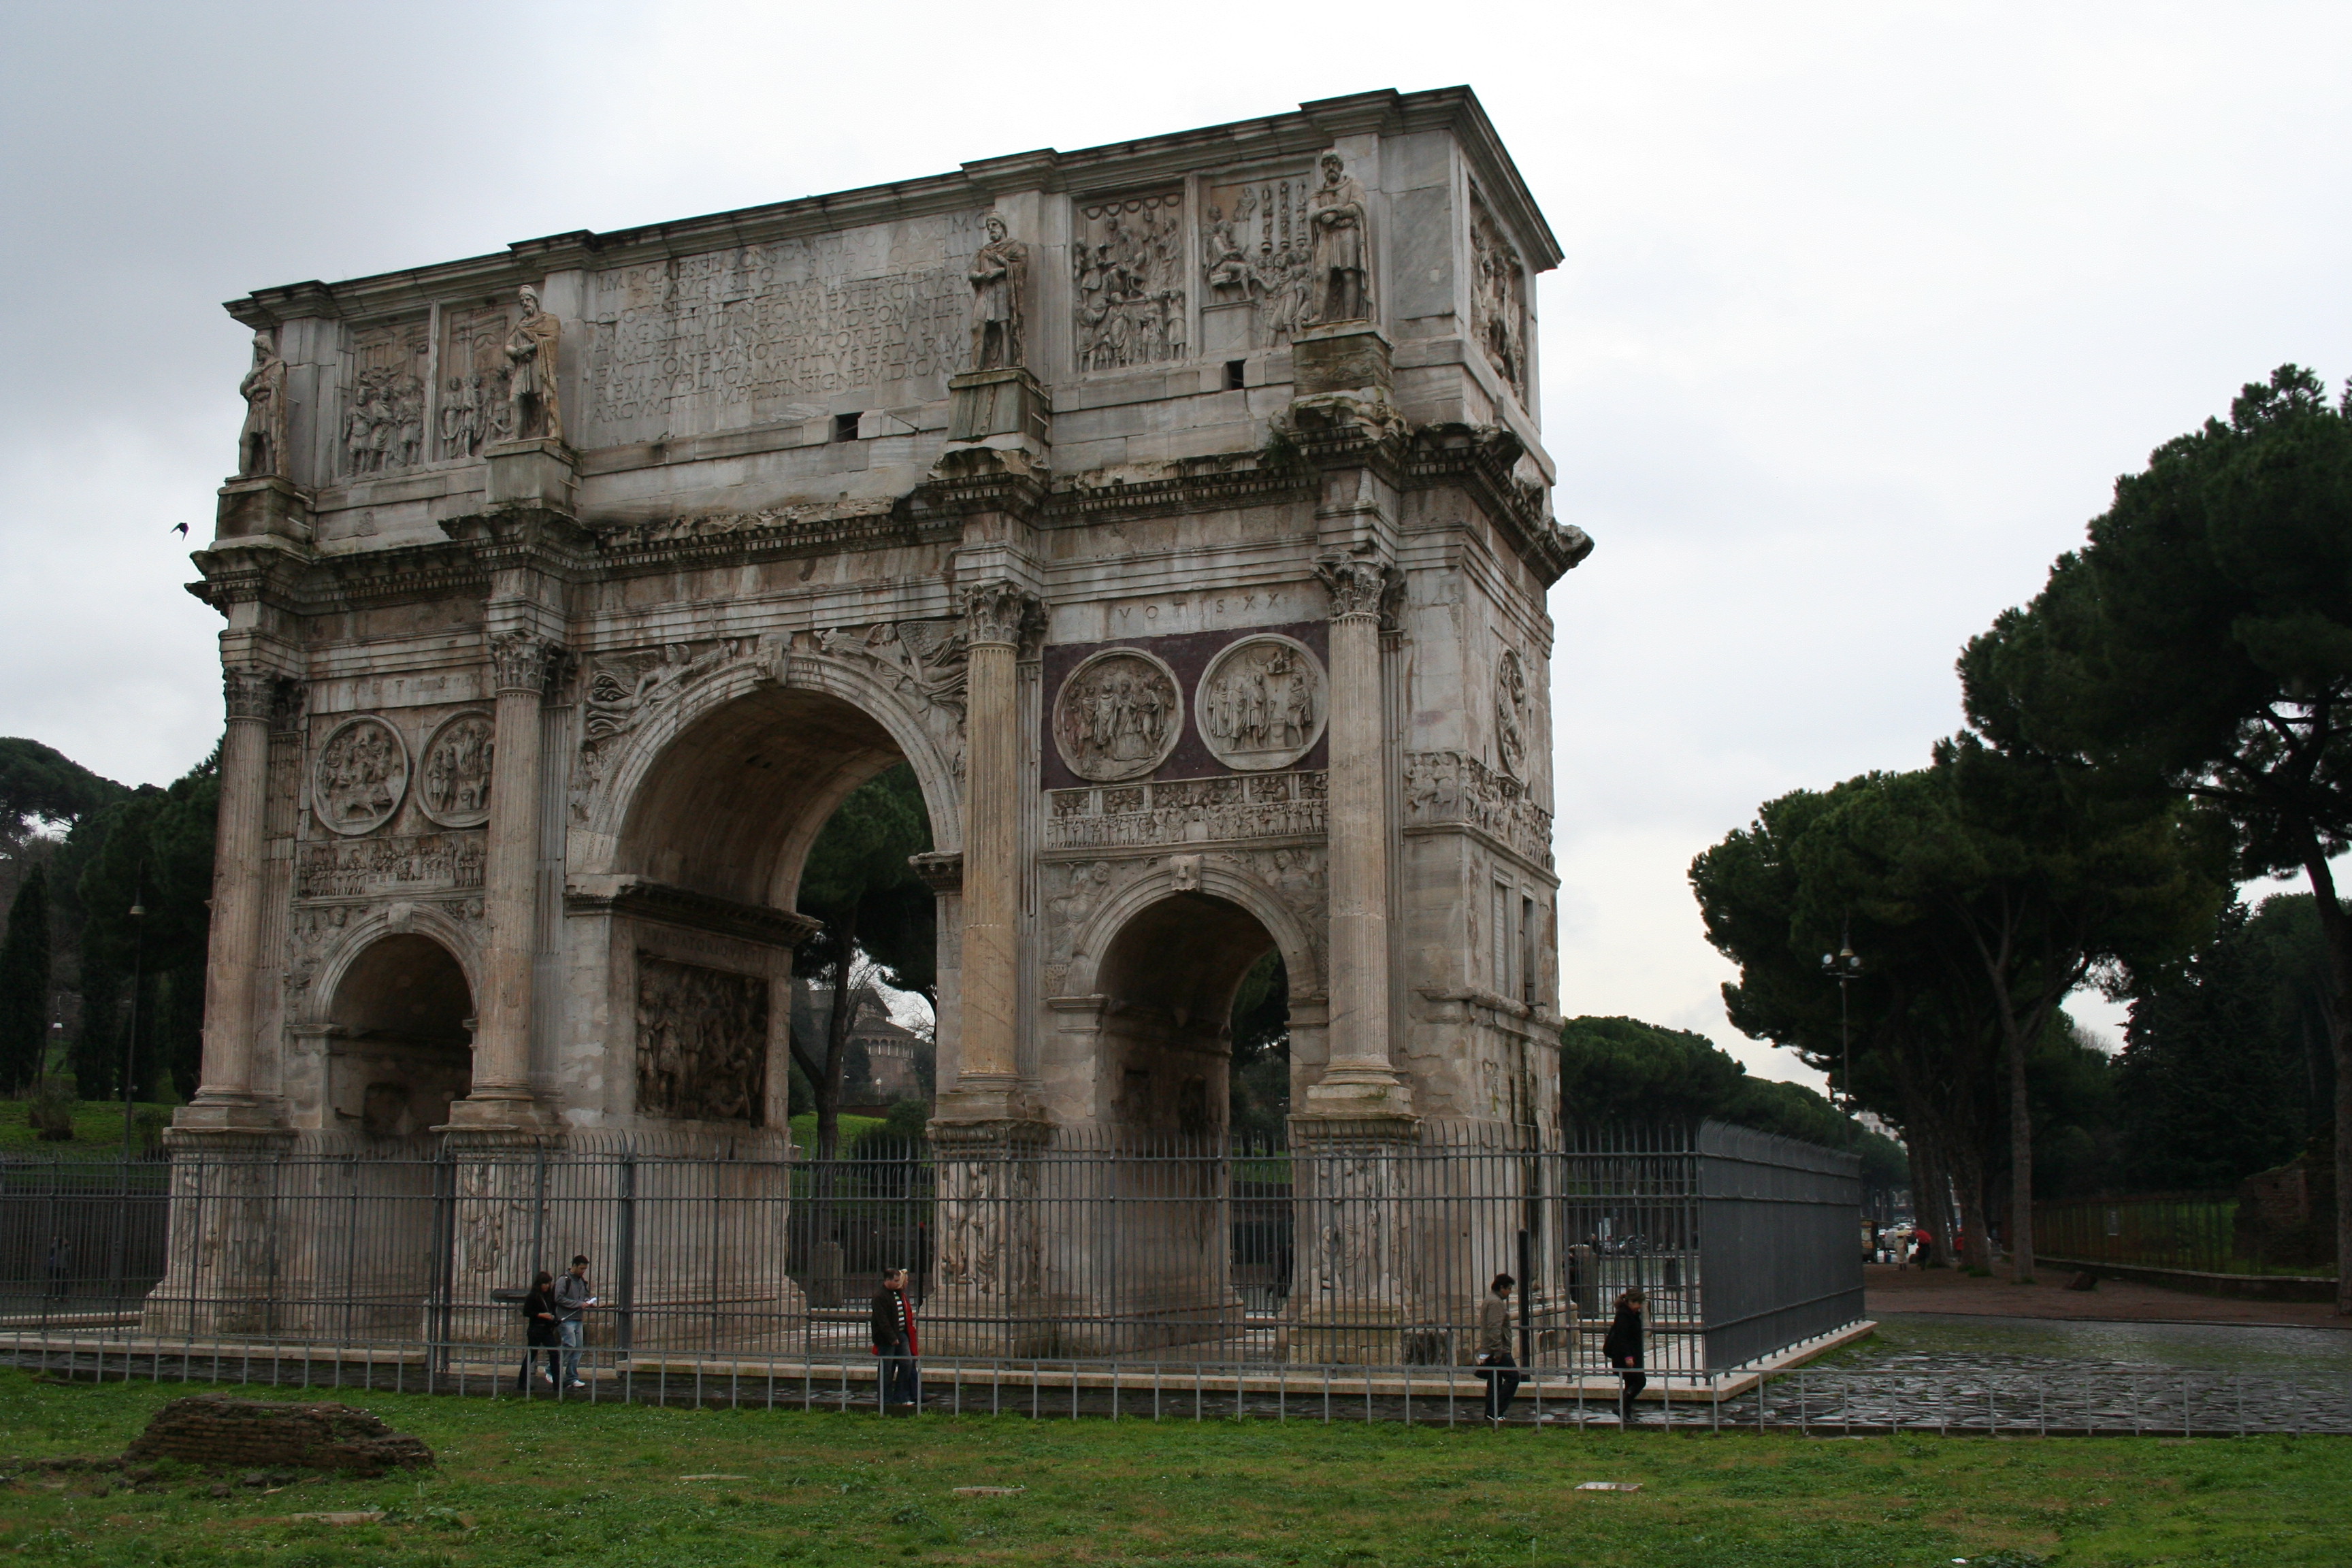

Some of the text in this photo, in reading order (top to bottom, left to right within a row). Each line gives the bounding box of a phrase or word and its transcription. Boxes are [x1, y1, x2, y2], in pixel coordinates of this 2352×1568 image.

[1118, 593, 1280, 619] VOTIS XX
[349, 676, 446, 695] VOTIS
